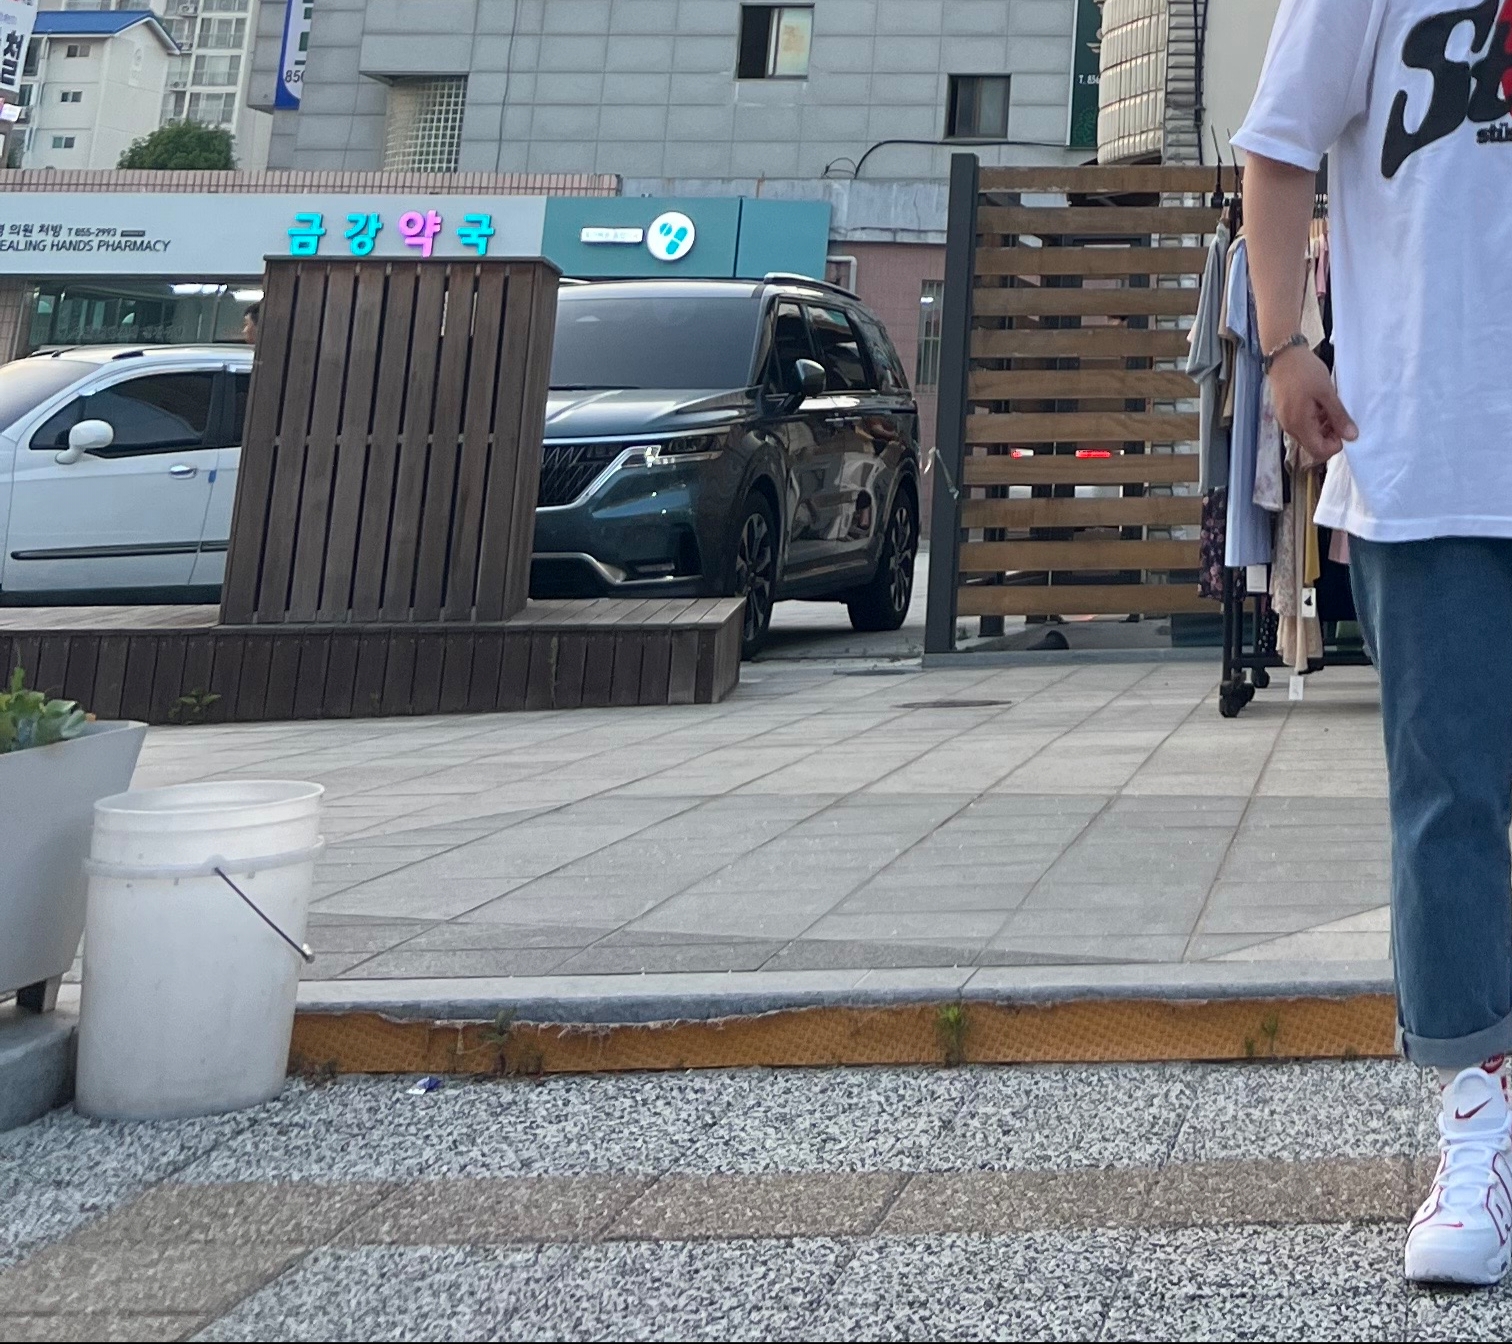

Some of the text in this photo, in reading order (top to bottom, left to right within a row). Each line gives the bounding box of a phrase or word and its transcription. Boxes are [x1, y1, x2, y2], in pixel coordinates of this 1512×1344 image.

[50, 239, 94, 252] HANDS
[96, 239, 172, 252] PHARMACY
[287, 209, 497, 258] 금강약국
